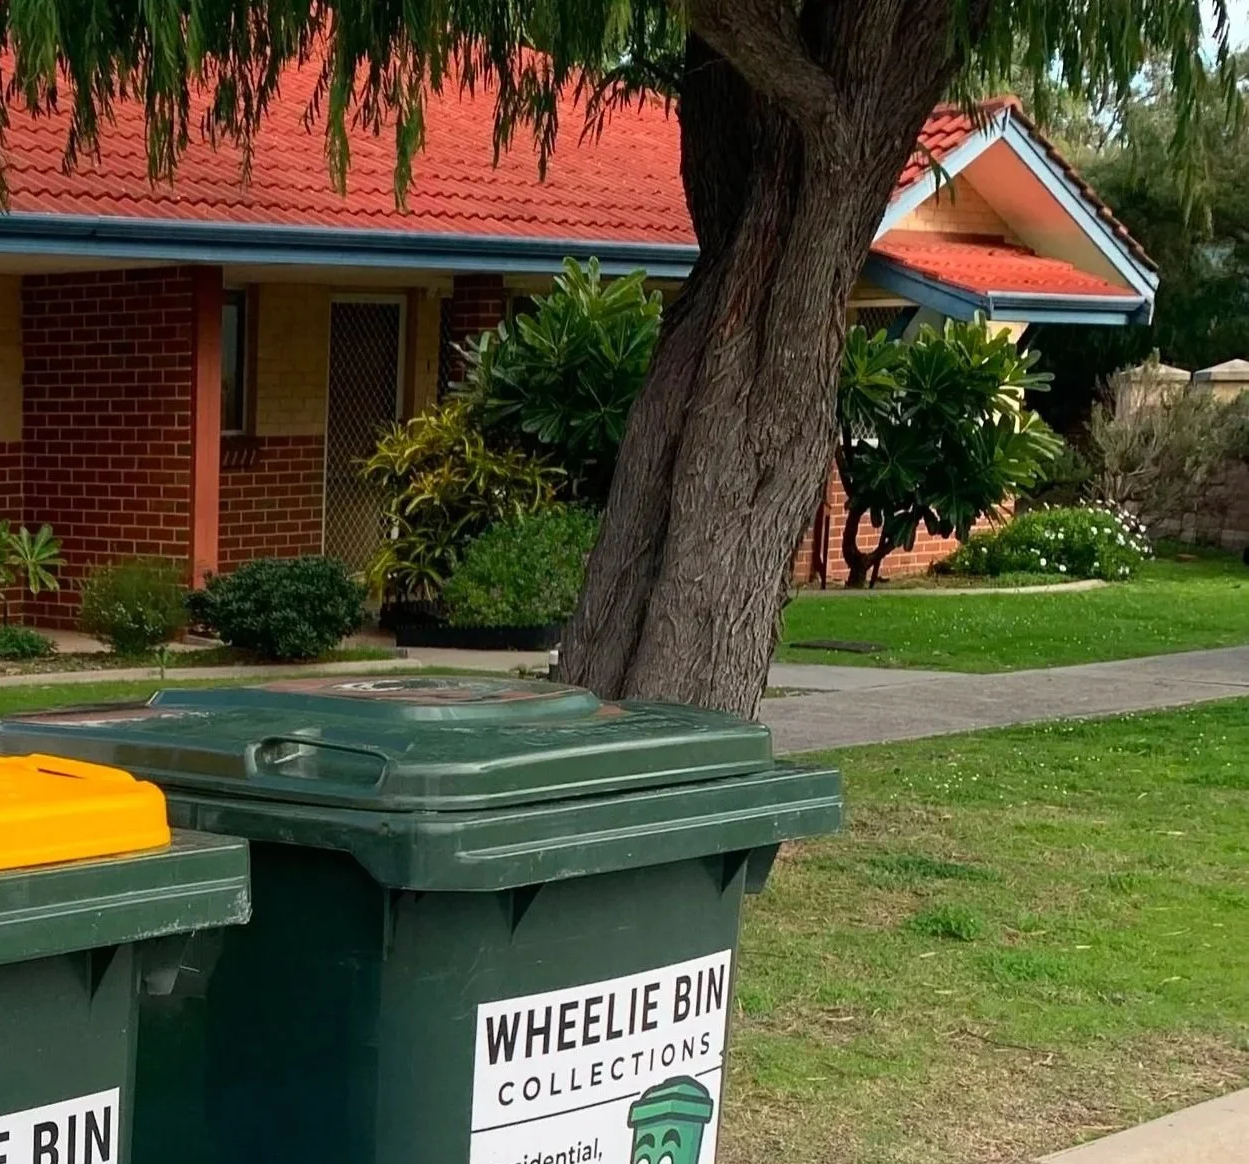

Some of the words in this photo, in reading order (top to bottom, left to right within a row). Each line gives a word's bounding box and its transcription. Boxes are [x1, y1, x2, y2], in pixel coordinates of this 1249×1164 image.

[485, 982, 661, 1065] WHEELIE
[673, 964, 725, 1023] BIN
[498, 1032, 711, 1106] COLLECTIONS
